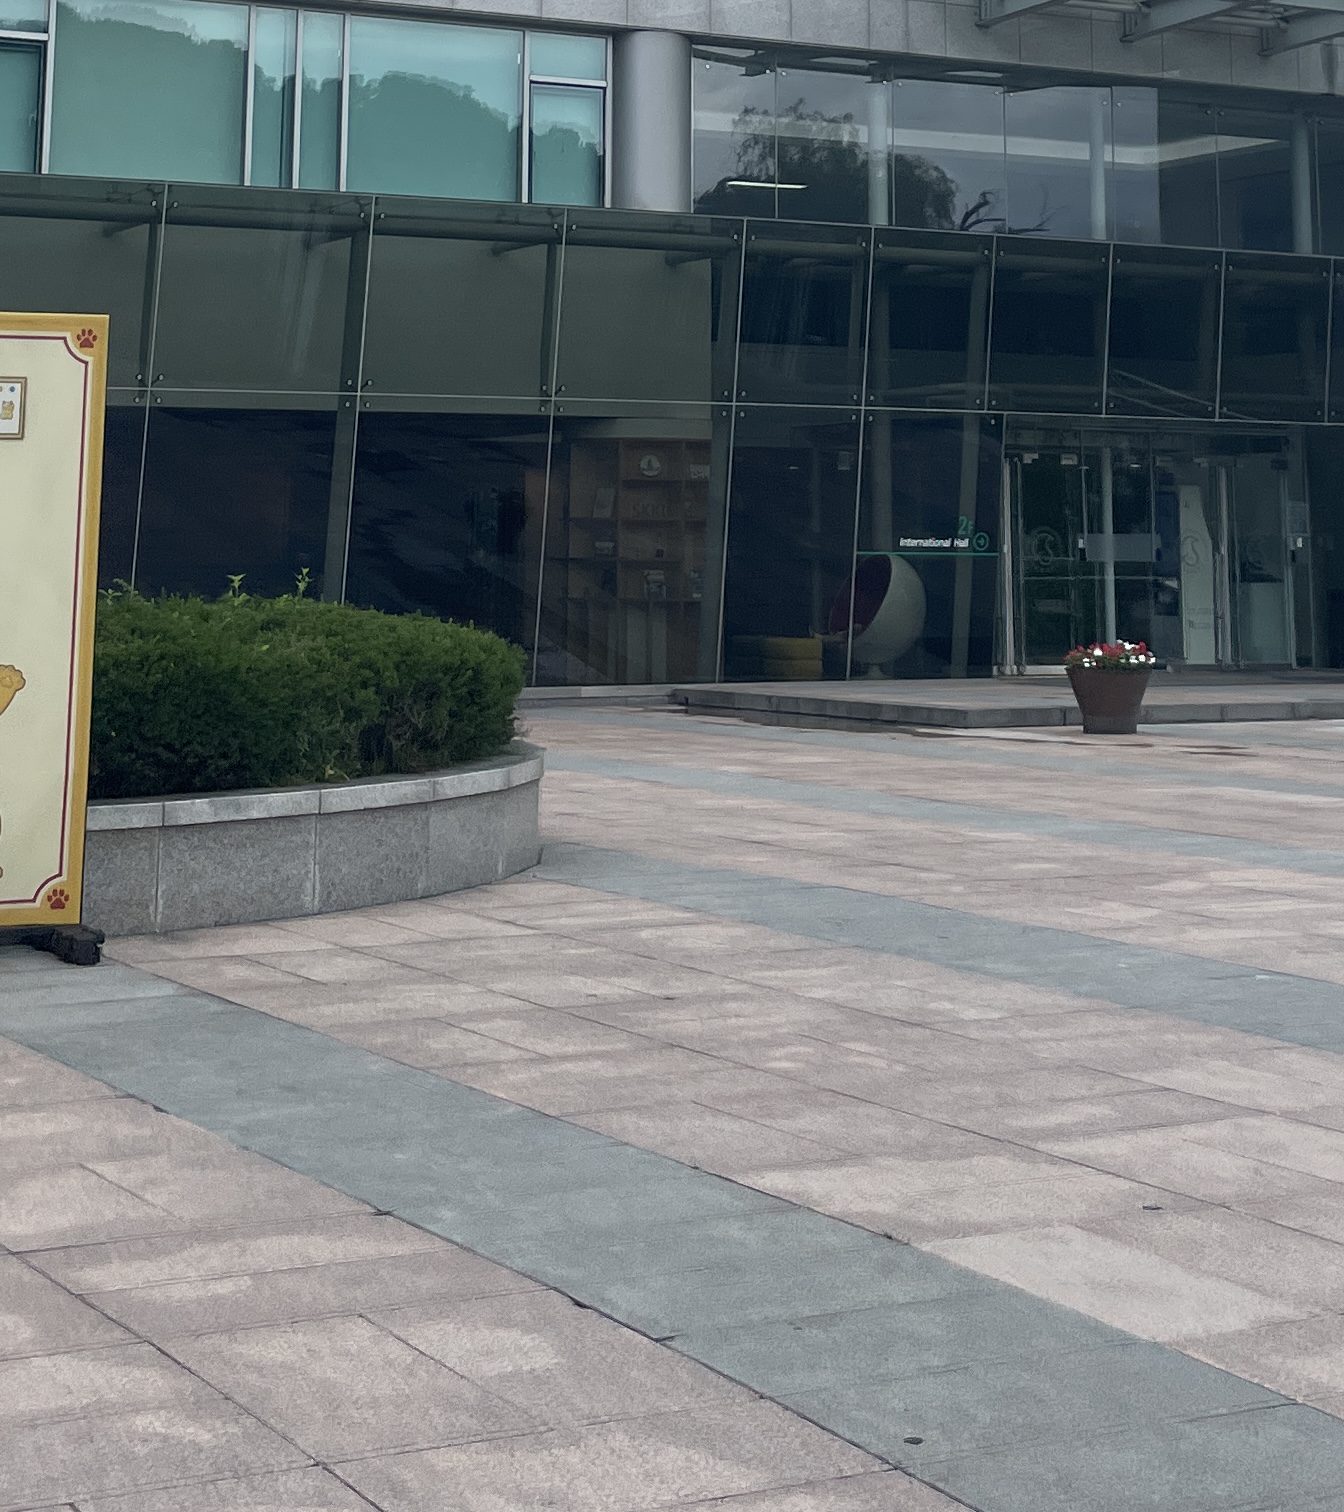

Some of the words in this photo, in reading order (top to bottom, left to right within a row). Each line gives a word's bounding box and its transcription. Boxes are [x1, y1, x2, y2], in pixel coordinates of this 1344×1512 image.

[957, 515, 974, 535] 2F
[899, 538, 951, 547] International
[954, 538, 969, 547] Hall
